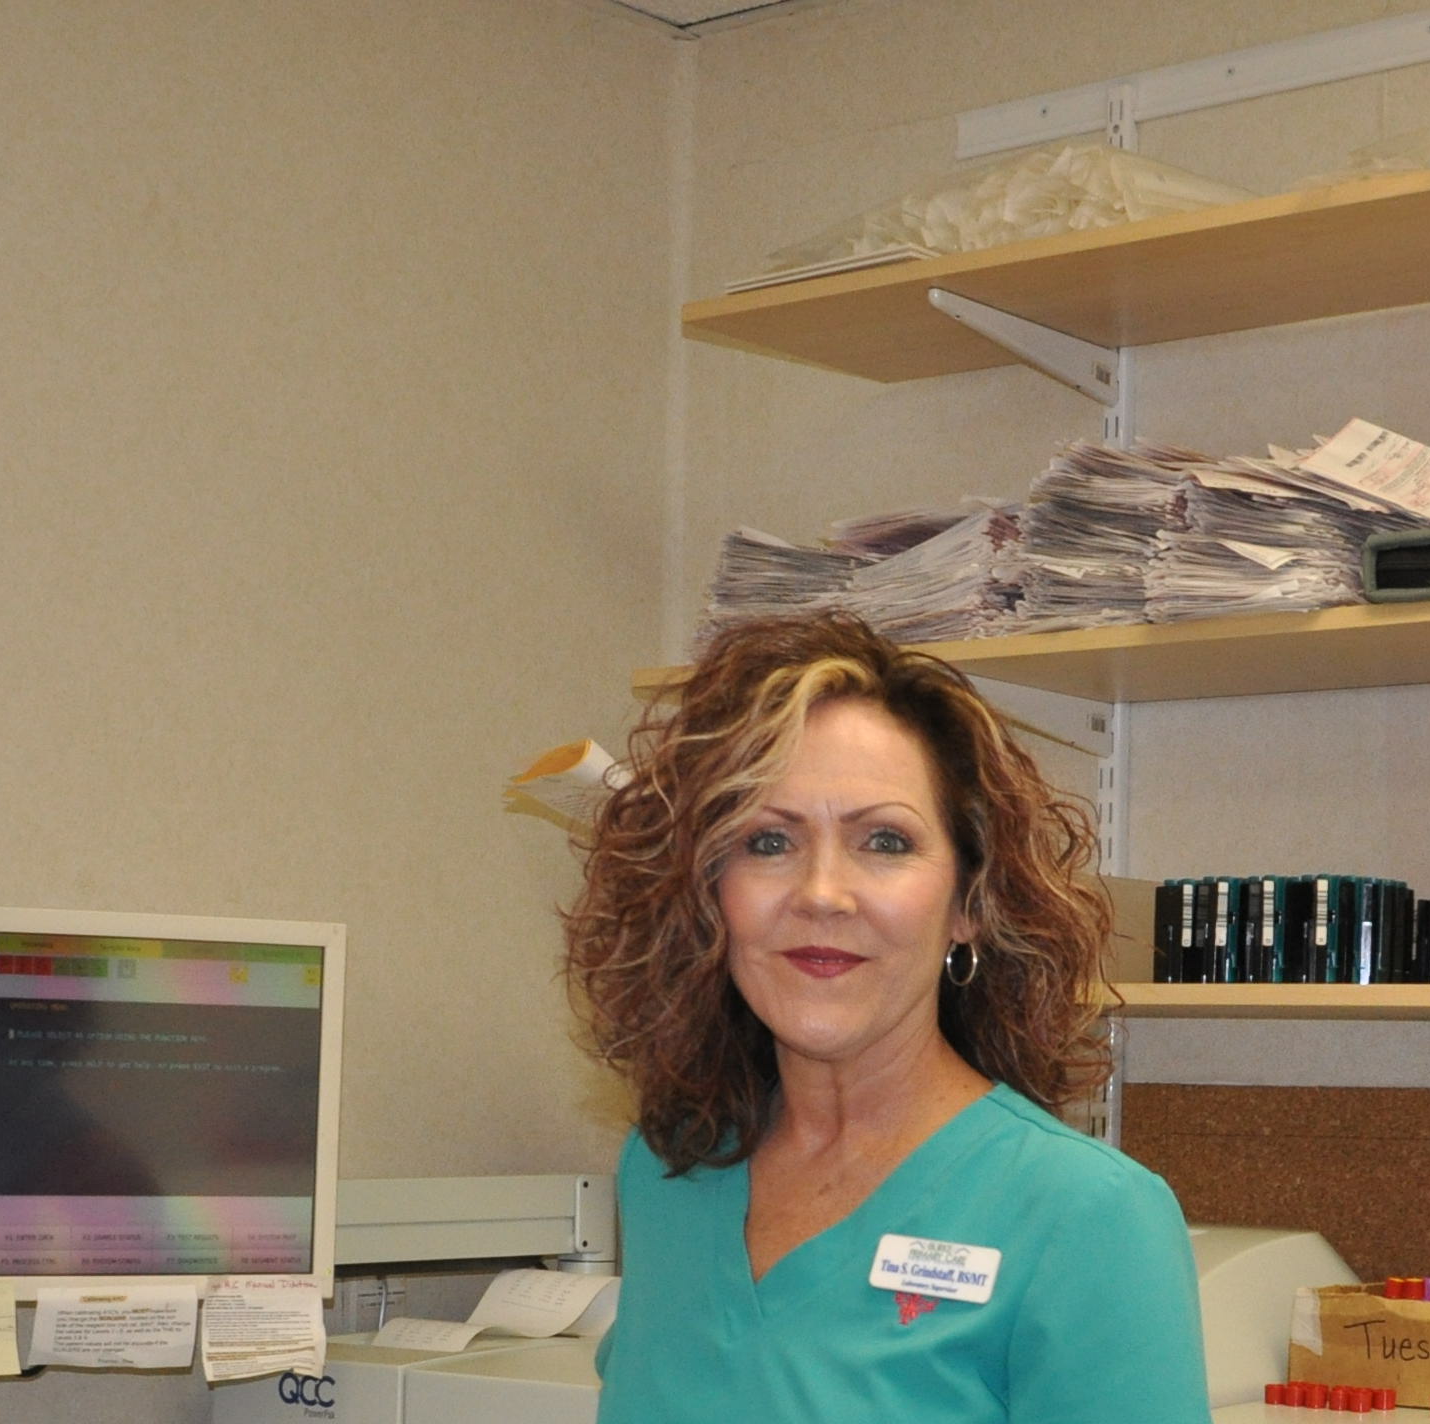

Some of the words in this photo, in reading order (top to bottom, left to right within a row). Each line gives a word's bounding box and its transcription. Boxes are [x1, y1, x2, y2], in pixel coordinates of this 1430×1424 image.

[881, 1259, 899, 1274] Tina
[944, 1253, 967, 1267] CARE
[278, 1372, 336, 1408] QCC
